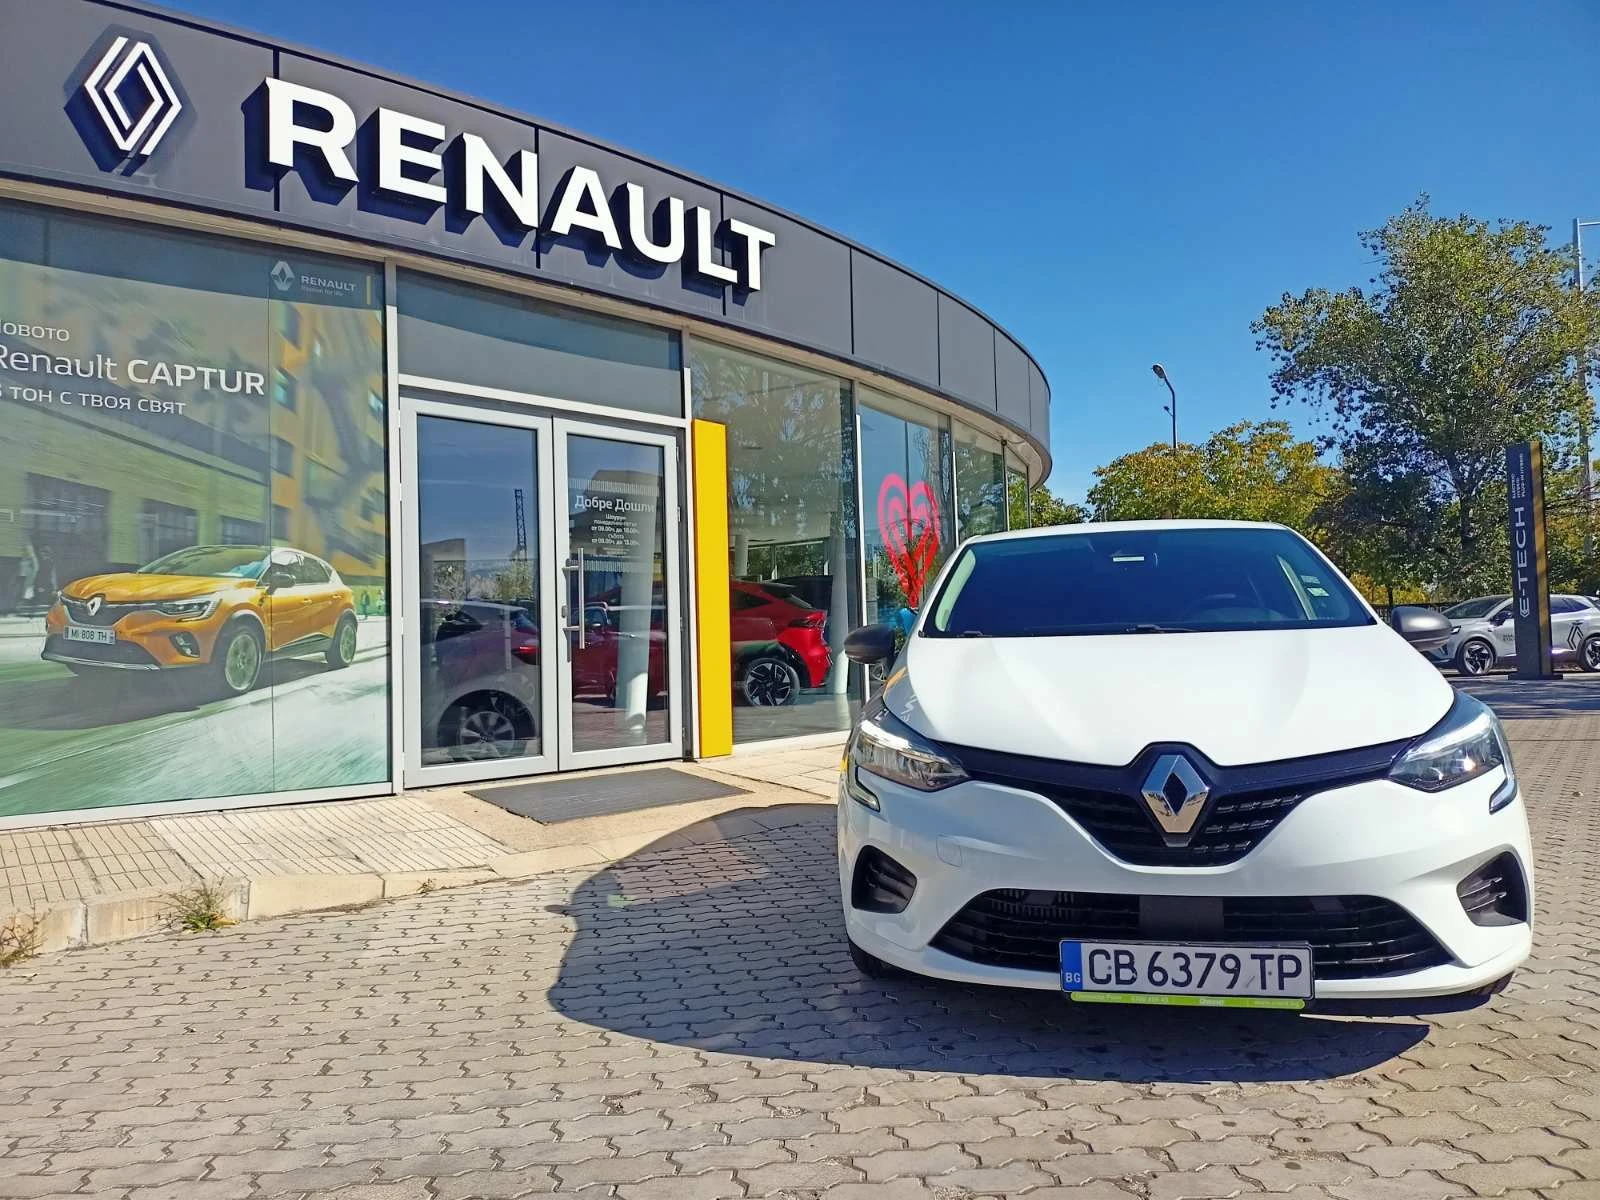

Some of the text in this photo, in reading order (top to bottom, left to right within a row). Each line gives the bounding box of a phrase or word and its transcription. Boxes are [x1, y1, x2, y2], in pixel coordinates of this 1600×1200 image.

[264, 76, 776, 293] RENAULT
[300, 274, 357, 292] RENAULT
[0, 319, 70, 342] ОВОТО
[0, 344, 265, 395] Renault CAPTUR
[9, 386, 53, 403] ТОН
[78, 392, 131, 411] ТВОЯ
[137, 398, 187, 415] СВЯТ
[574, 495, 613, 511] Добре
[1514, 506, 1530, 618] E-TECH
[1064, 971, 1081, 983] BG
[1088, 949, 1302, 991] CB 6379 TP
